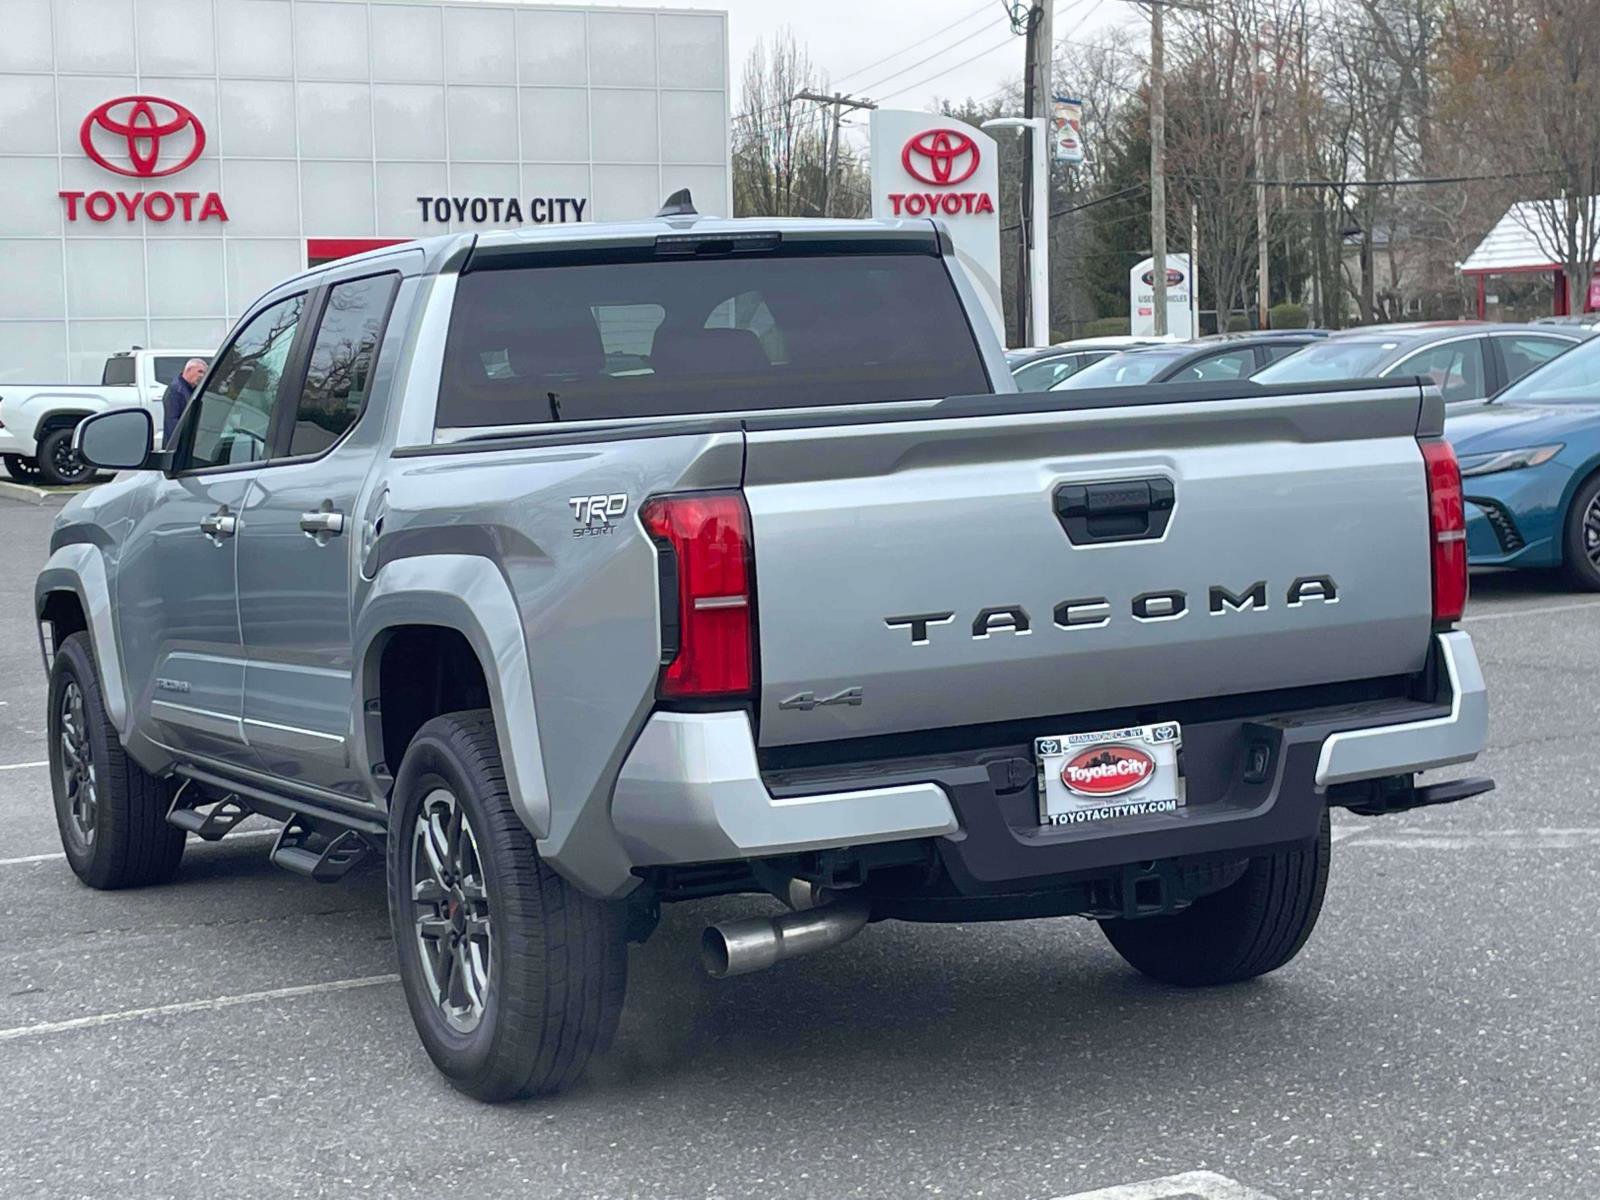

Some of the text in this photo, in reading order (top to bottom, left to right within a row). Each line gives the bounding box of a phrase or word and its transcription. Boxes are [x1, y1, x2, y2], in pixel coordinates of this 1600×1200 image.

[58, 190, 229, 222] TOYOTA
[416, 197, 587, 223] TOYOTA CITY
[887, 192, 995, 216] TOYOTA
[568, 493, 629, 526] TRD
[572, 524, 618, 538] SPORT
[883, 574, 1340, 646] TACOMA
[1050, 800, 1176, 826] TOYOTACITYNY.COM
